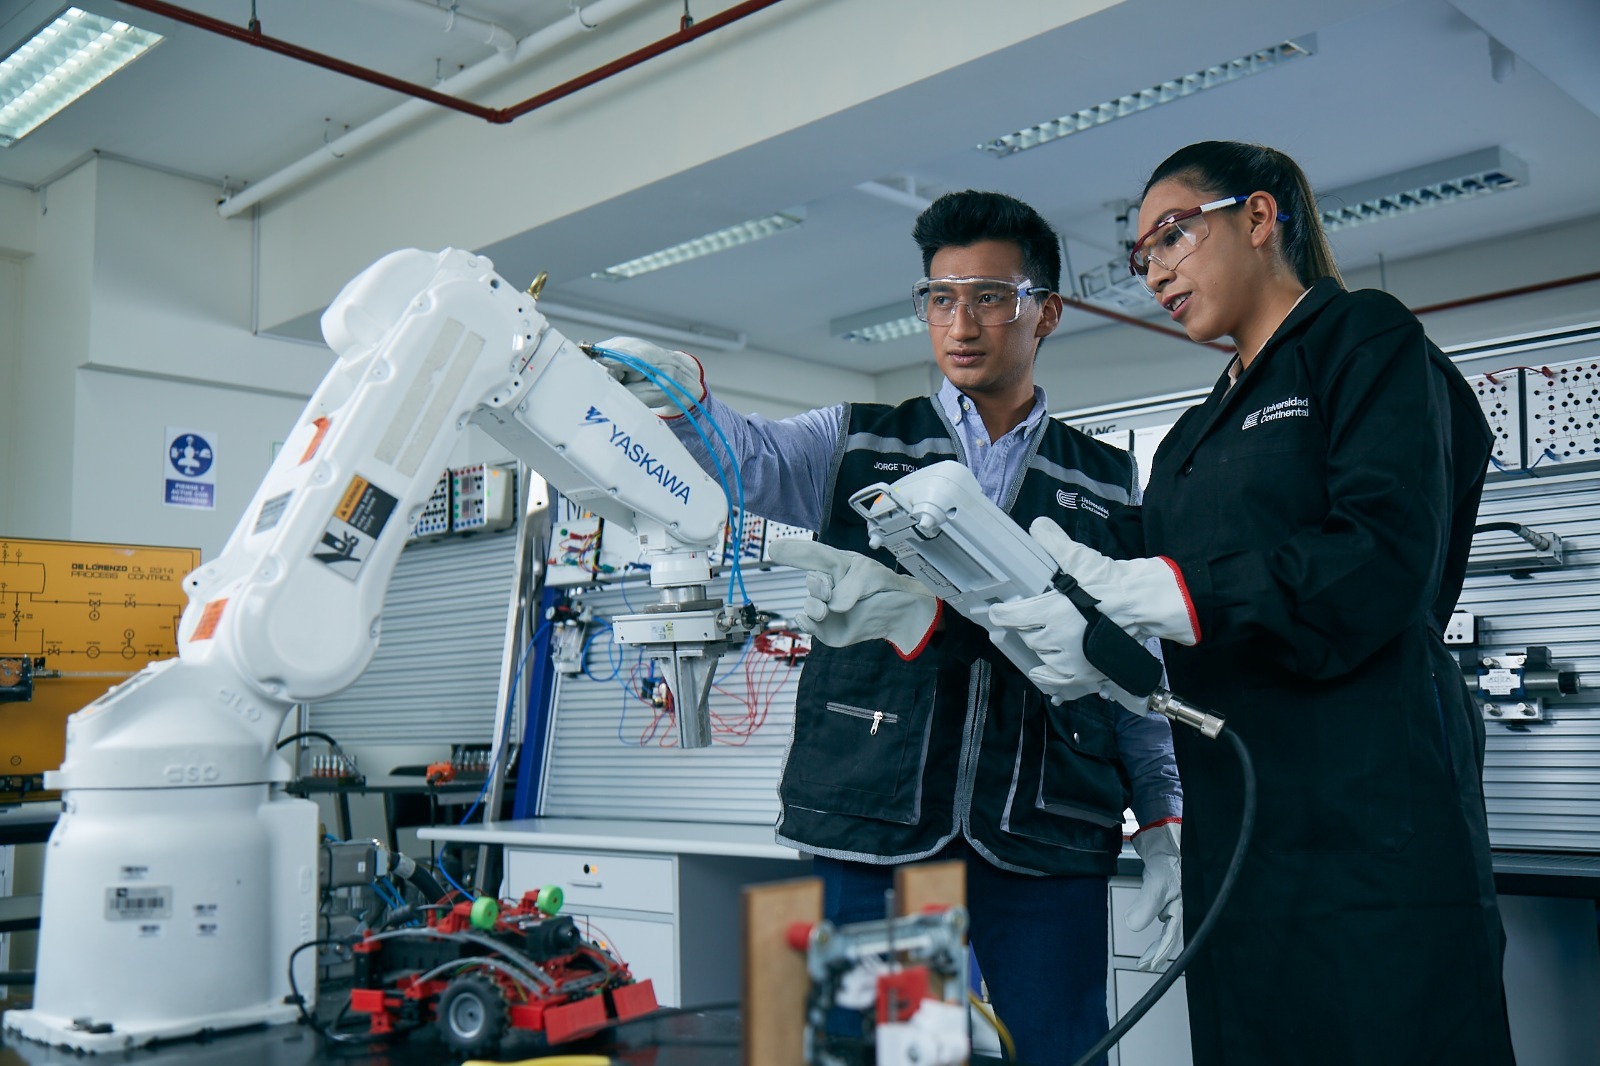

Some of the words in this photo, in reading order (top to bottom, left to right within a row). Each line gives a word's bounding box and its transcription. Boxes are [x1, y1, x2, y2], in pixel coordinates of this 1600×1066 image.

[1263, 397, 1308, 415] Universidad
[1261, 408, 1308, 423] Continental
[609, 424, 690, 505] YASKAWA
[873, 462, 898, 471] JORGE
[86, 563, 128, 572] LORENZO
[71, 571, 118, 579] PROCESS
[127, 573, 173, 581] CONTROL
